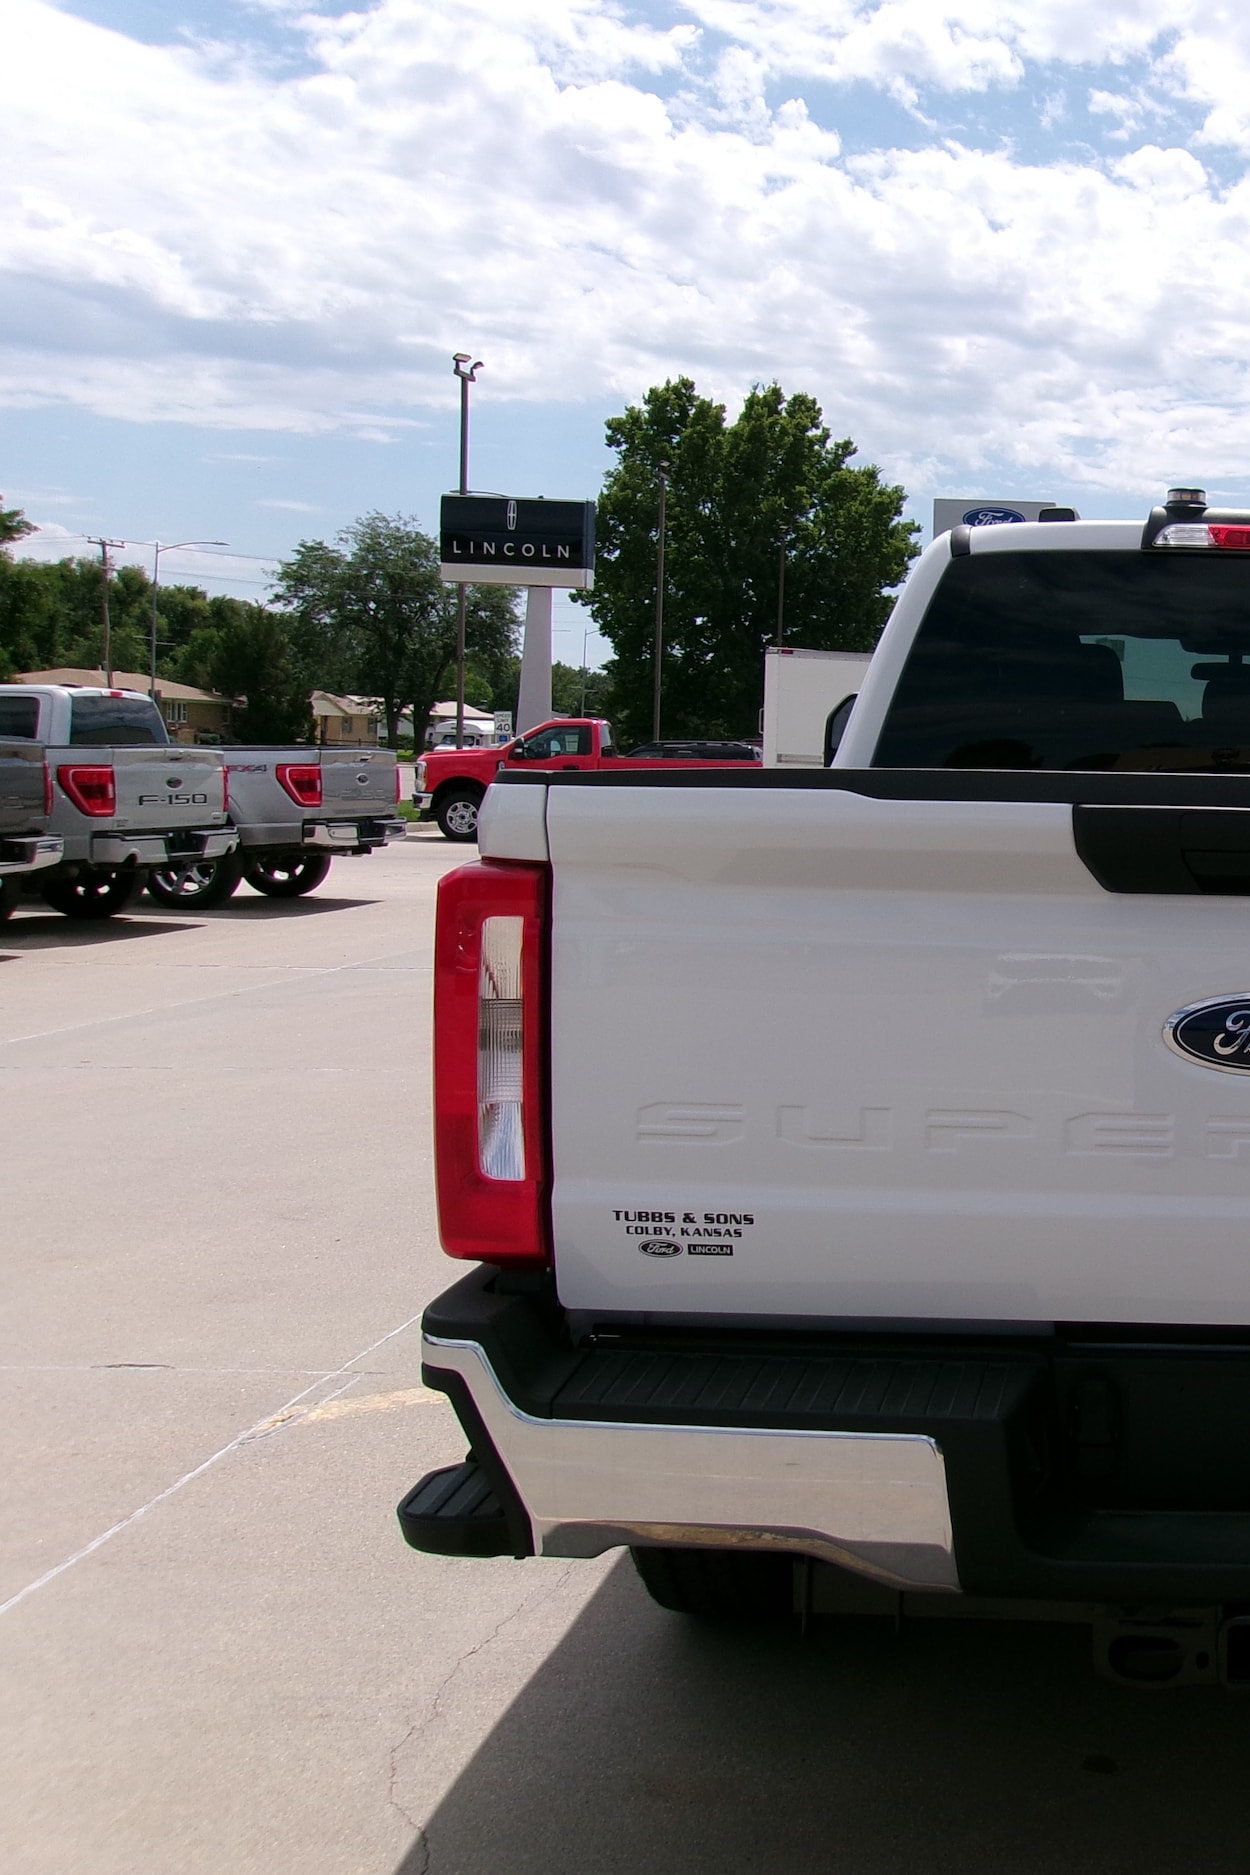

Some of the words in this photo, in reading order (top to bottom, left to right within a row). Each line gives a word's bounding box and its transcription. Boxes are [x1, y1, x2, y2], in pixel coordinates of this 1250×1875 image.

[452, 540, 570, 559] LINCOLN
[496, 723, 510, 732] 40
[138, 793, 208, 806] F-150
[612, 1210, 676, 1223] TUBBS
[682, 1212, 697, 1224] &
[703, 1213, 754, 1225] SONS
[626, 1225, 676, 1238] COLBY,
[680, 1227, 743, 1238] KANSAS
[690, 1245, 731, 1255] LINCOLN
